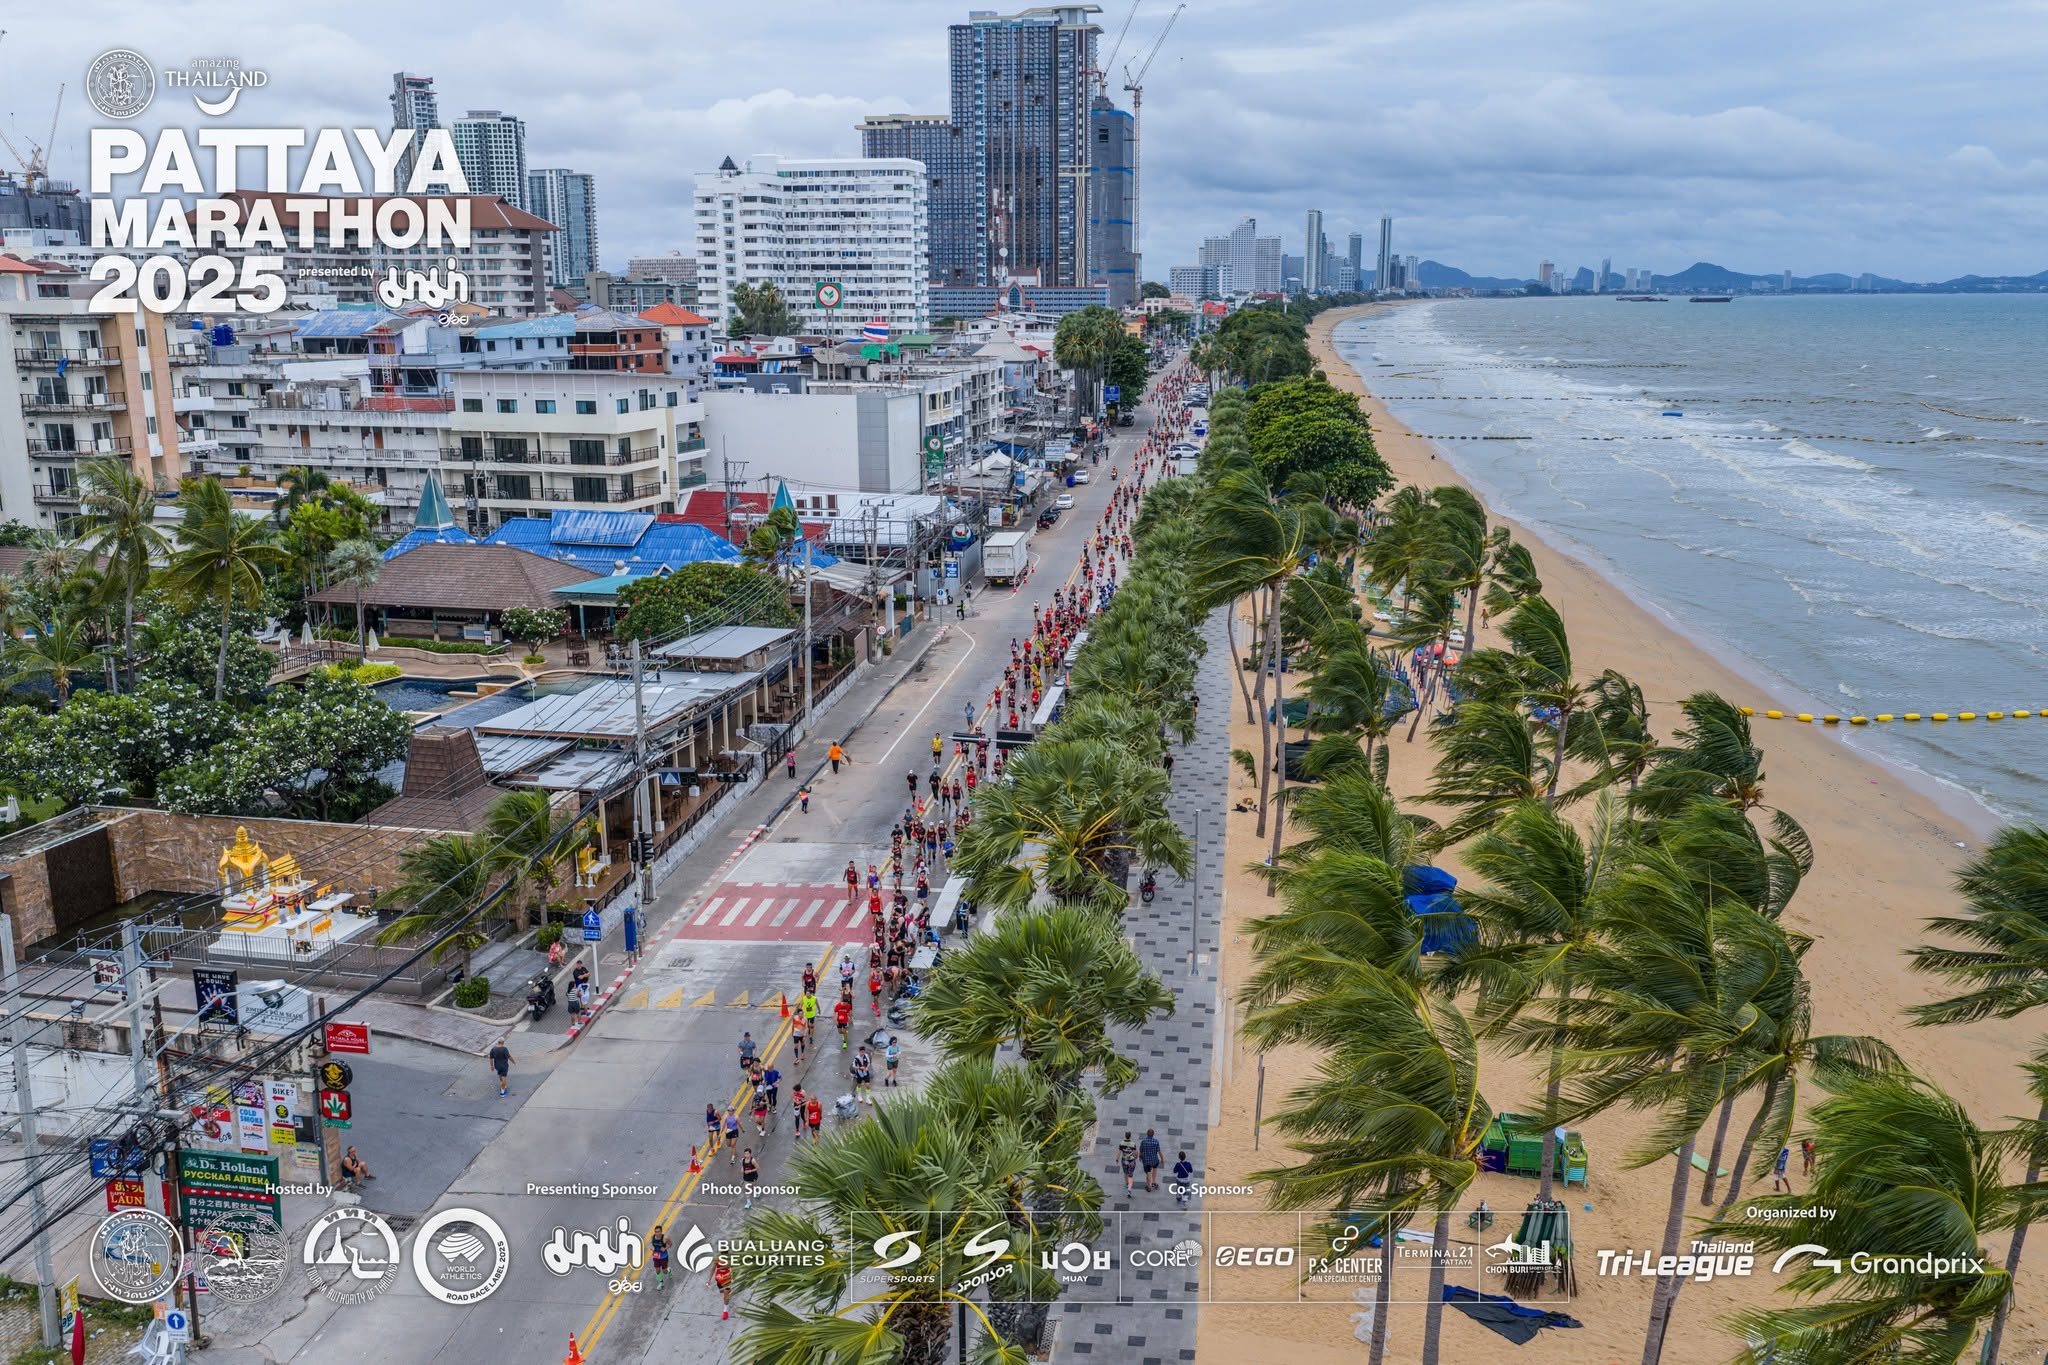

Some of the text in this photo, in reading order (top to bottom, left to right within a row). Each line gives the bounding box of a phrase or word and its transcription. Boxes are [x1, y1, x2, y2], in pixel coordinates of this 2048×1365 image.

[272, 1088, 294, 1097] BIKE?
[239, 1108, 257, 1117] COLD
[239, 1115, 263, 1124] SMOKE
[220, 1161, 268, 1175] Holland
[184, 1170, 271, 1185] РУССКАЯ АПТЕКА
